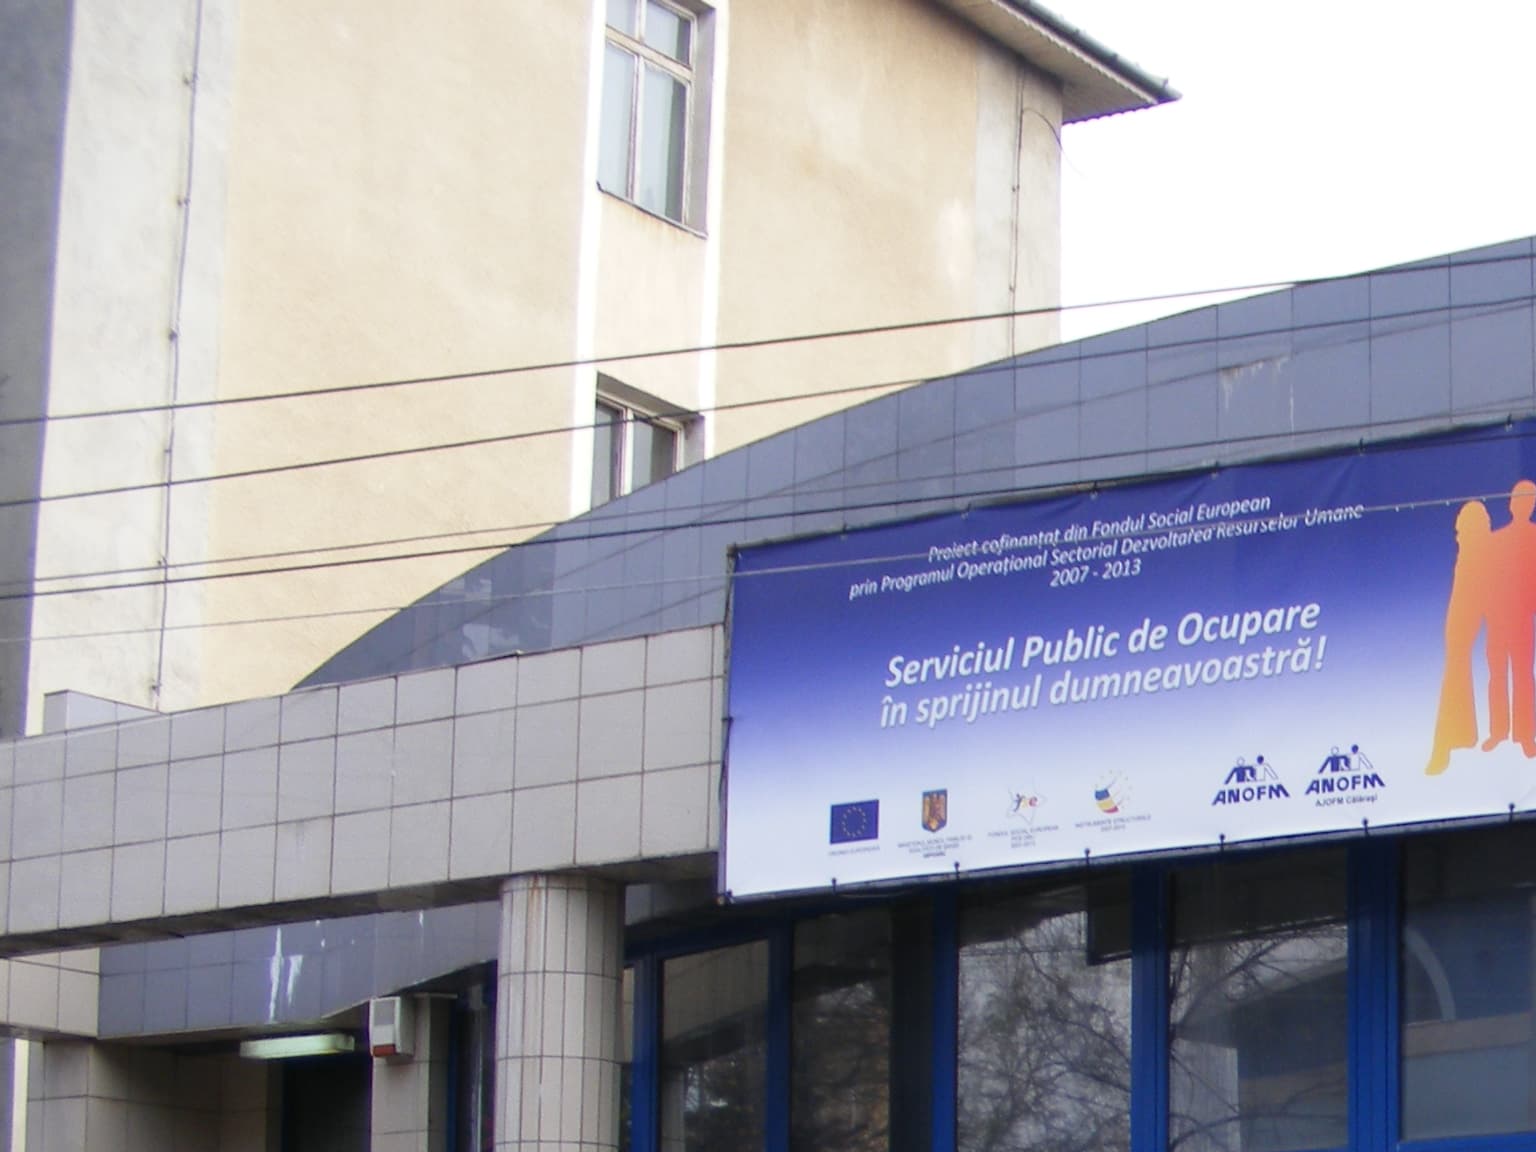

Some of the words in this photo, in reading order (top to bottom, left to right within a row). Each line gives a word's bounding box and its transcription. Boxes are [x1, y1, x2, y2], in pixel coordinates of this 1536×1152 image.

[849, 580, 878, 600] prin
[881, 566, 954, 592] Programul
[1050, 540, 1117, 566] Sectorial
[1121, 528, 1212, 555] Dezvoltarea
[1216, 513, 1299, 538] Resurselor
[1305, 504, 1364, 526] Umane
[928, 540, 978, 563] Proiect
[1064, 524, 1088, 541] din
[1092, 513, 1144, 537] Fondul
[1148, 505, 1194, 529] Social
[1197, 496, 1271, 520] European
[1050, 566, 1089, 587] 2007
[1102, 559, 1142, 580] 2013
[885, 637, 1015, 688] Serviciul
[1021, 625, 1120, 668] Public
[1128, 618, 1168, 654] de
[1177, 602, 1321, 645] Ocupare
[880, 695, 907, 729] în
[915, 674, 1042, 729] sprijinul
[1050, 635, 1327, 705] dumneavoastră!
[1212, 784, 1290, 806] ANOFM
[1305, 773, 1385, 795] ANOFM
